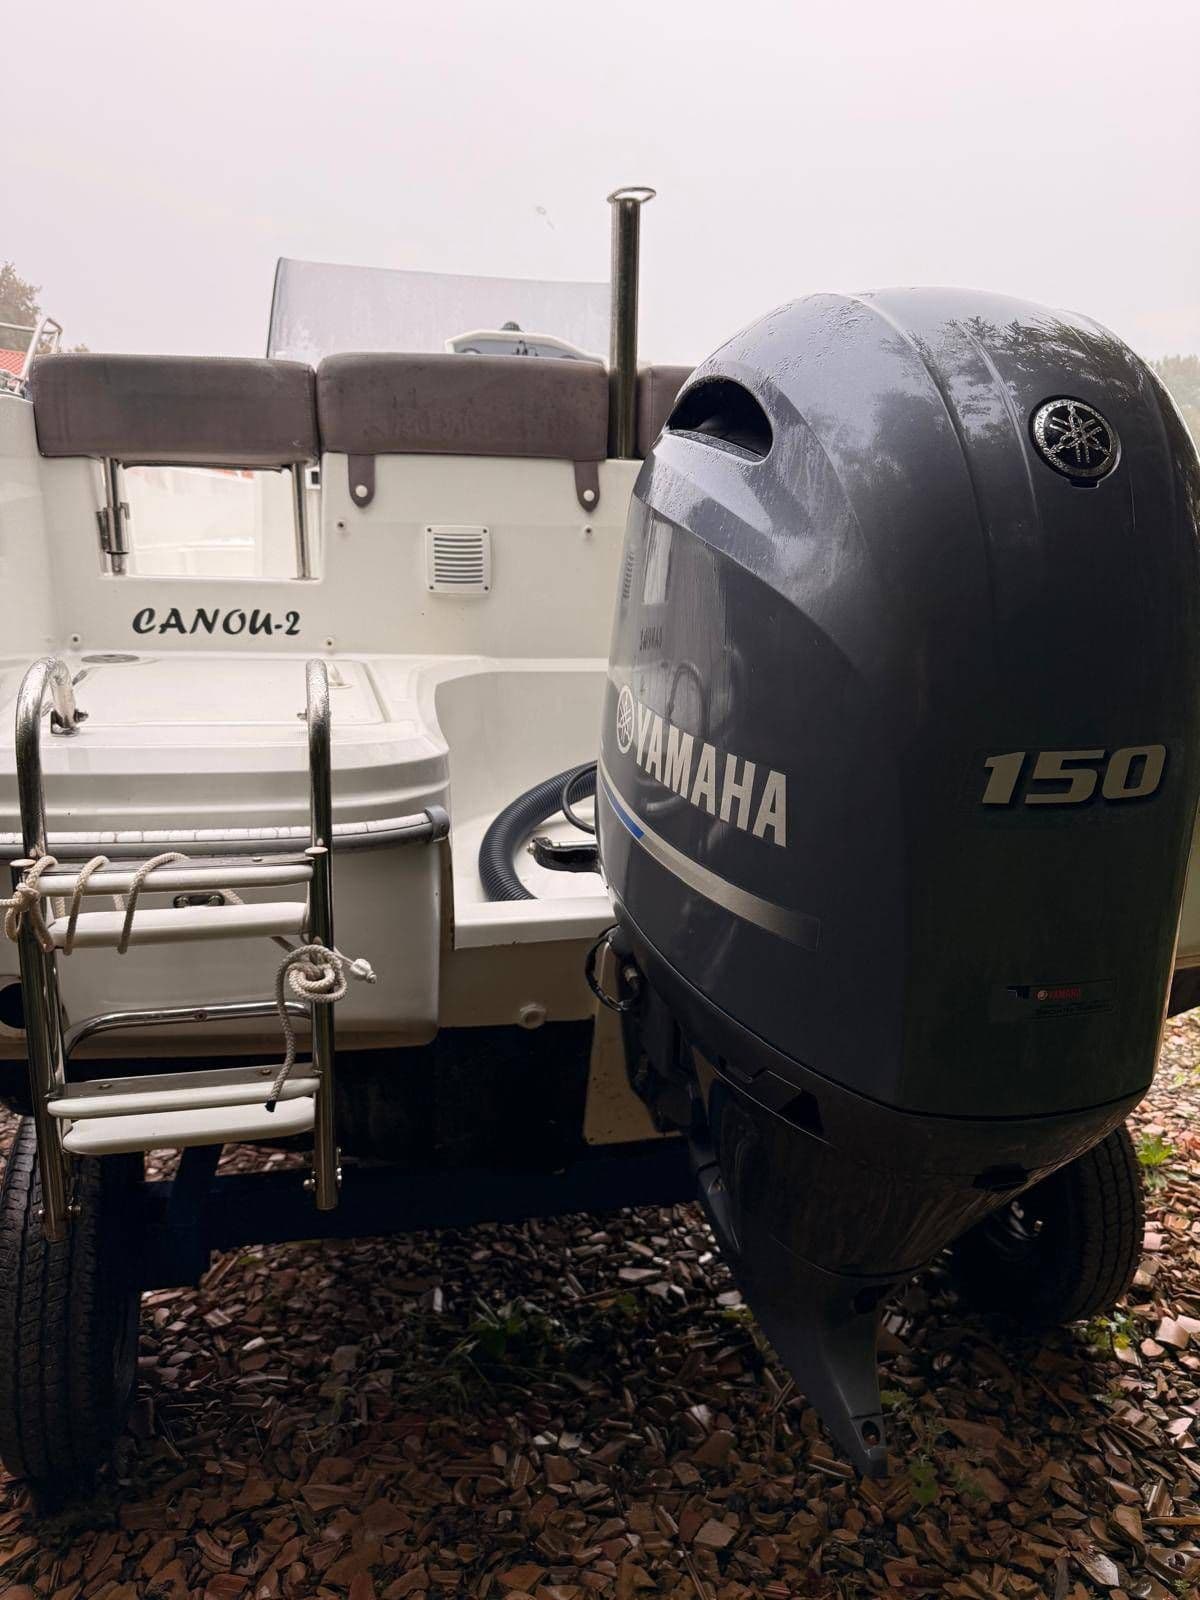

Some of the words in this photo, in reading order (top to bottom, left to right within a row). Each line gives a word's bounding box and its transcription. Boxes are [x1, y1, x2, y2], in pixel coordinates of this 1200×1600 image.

[132, 607, 301, 636] CANOU-2
[636, 700, 787, 848] YAMAHA
[982, 744, 1166, 804] 150
